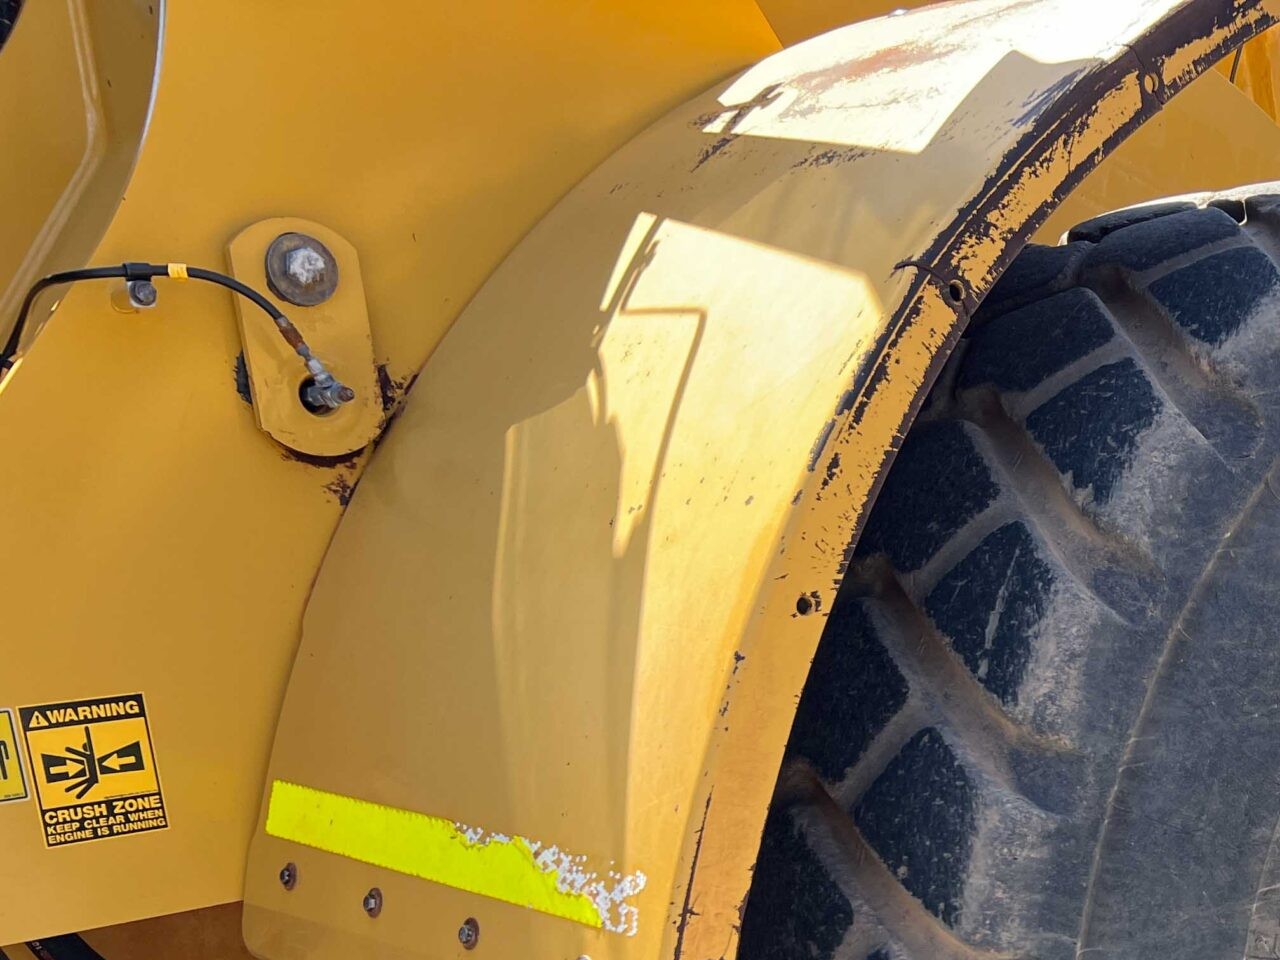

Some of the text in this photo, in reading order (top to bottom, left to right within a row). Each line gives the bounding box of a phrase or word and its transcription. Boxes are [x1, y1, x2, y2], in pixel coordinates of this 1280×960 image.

[46, 701, 140, 724] WARNING
[44, 803, 108, 824] CRUSH
[112, 795, 162, 814] ZONE
[46, 809, 163, 835] KEEP CLEAR WHEN
[48, 818, 166, 845] ENGINE IS RUNNING
